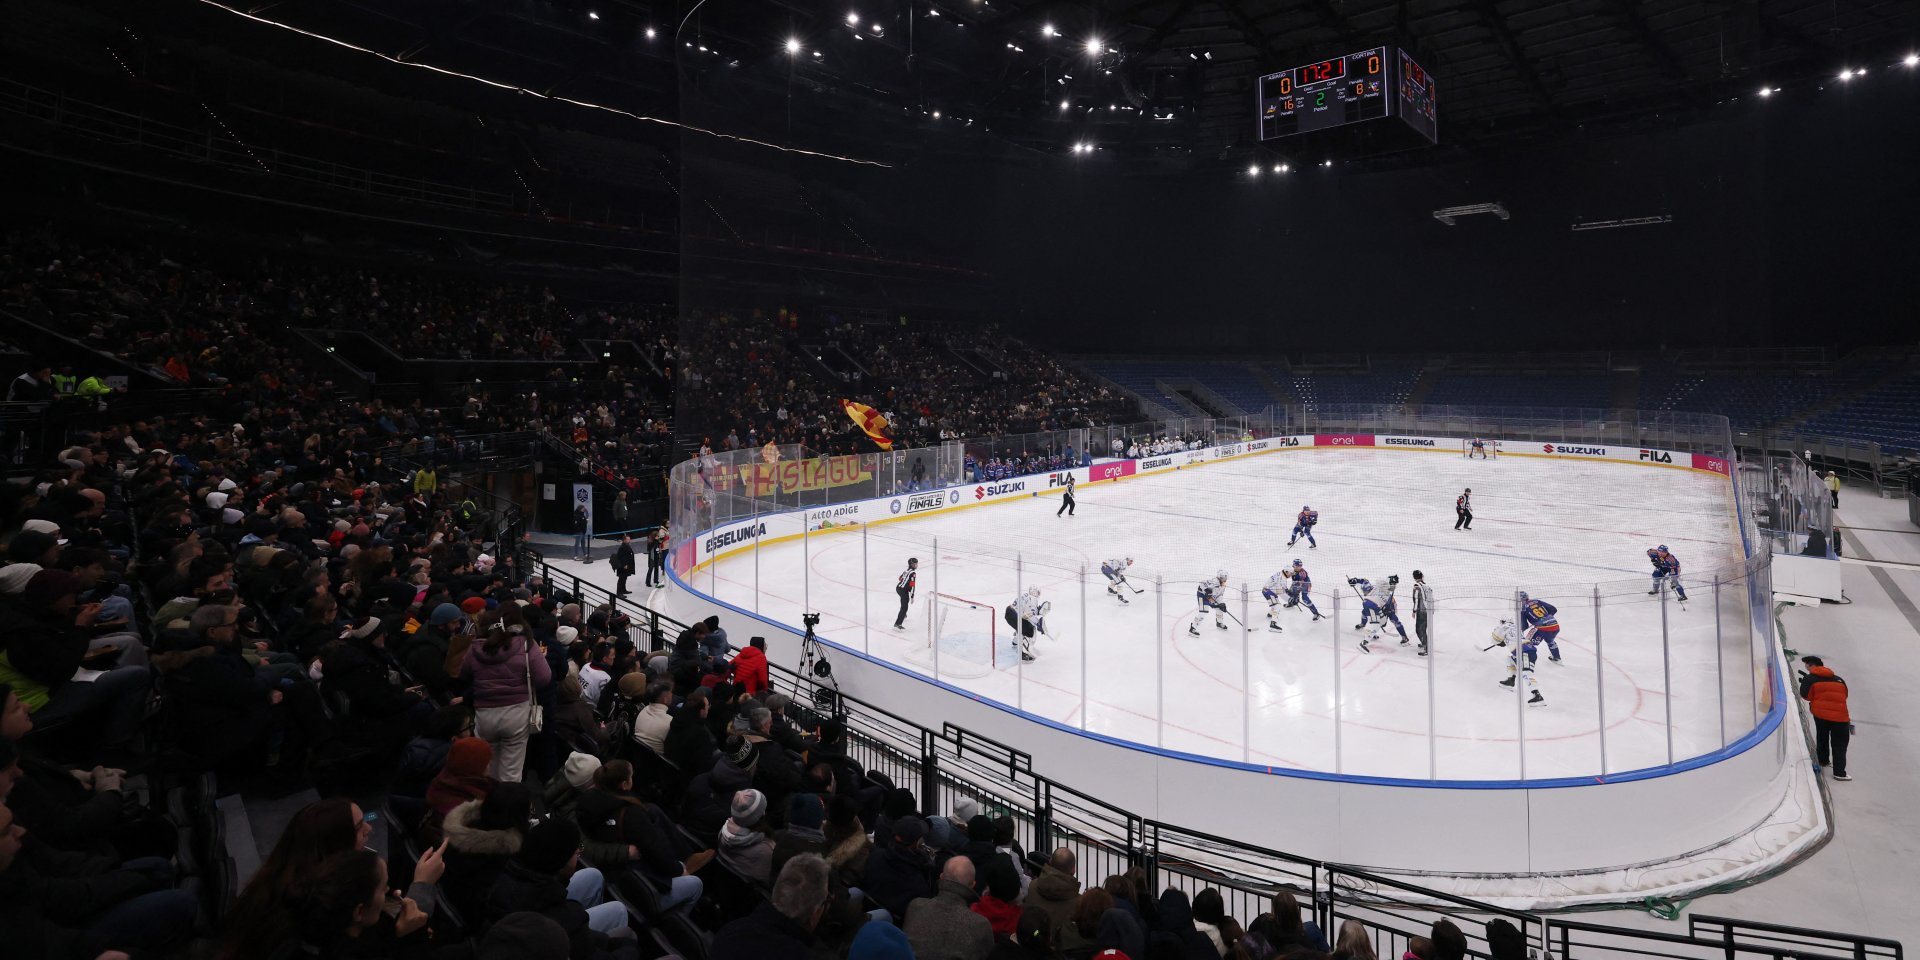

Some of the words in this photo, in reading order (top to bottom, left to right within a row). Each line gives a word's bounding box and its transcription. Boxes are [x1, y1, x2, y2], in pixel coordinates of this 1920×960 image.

[1303, 60, 1343, 83] 17:21
[1368, 56, 1380, 74] 0
[1280, 77, 1291, 94] 0
[1356, 83, 1364, 94] 8
[1284, 100, 1294, 110] 16
[1316, 92, 1325, 105] 2
[1280, 437, 1299, 447] FILA
[1332, 435, 1355, 445] enel
[1385, 438, 1435, 446] ESSELUNGA
[1557, 446, 1605, 455] SUZUKI
[1640, 449, 1672, 463] FILA
[1142, 458, 1172, 470] ESSELUNGA
[767, 456, 860, 492] ASIAGO
[1104, 464, 1123, 478] enel
[1049, 471, 1073, 488] FILA
[987, 481, 1025, 496] SUZUKI
[909, 497, 942, 510] FINALS
[706, 522, 767, 554] ESSELUNGA
